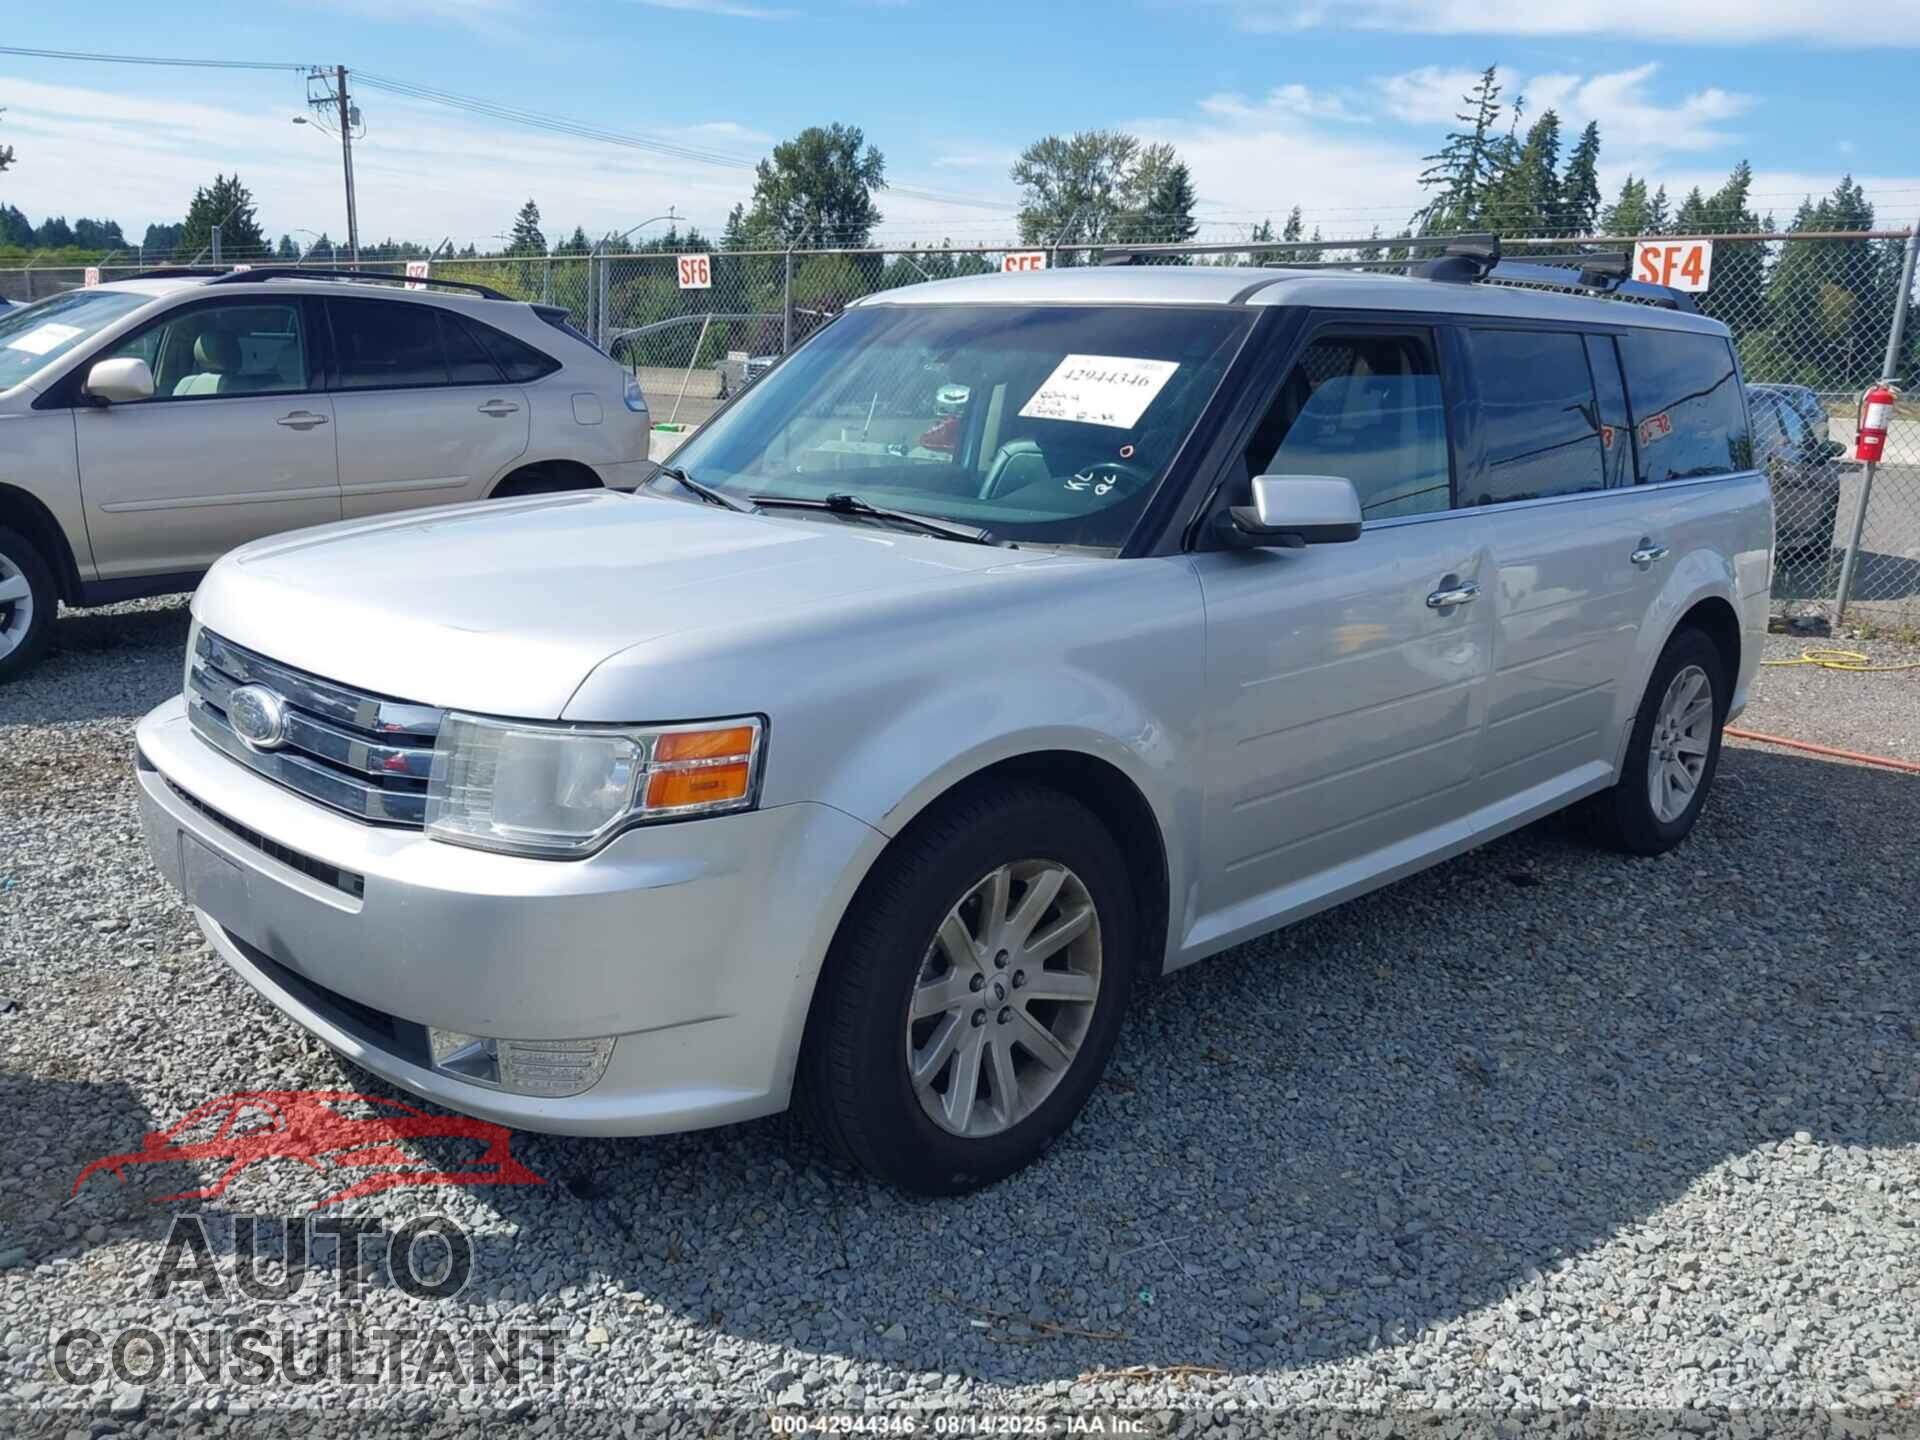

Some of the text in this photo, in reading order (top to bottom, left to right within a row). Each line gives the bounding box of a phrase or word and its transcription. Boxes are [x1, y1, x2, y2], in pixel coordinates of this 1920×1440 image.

[681, 259, 708, 285] SF6
[1639, 246, 1704, 288] SF4
[1063, 369, 1150, 386] 42944346
